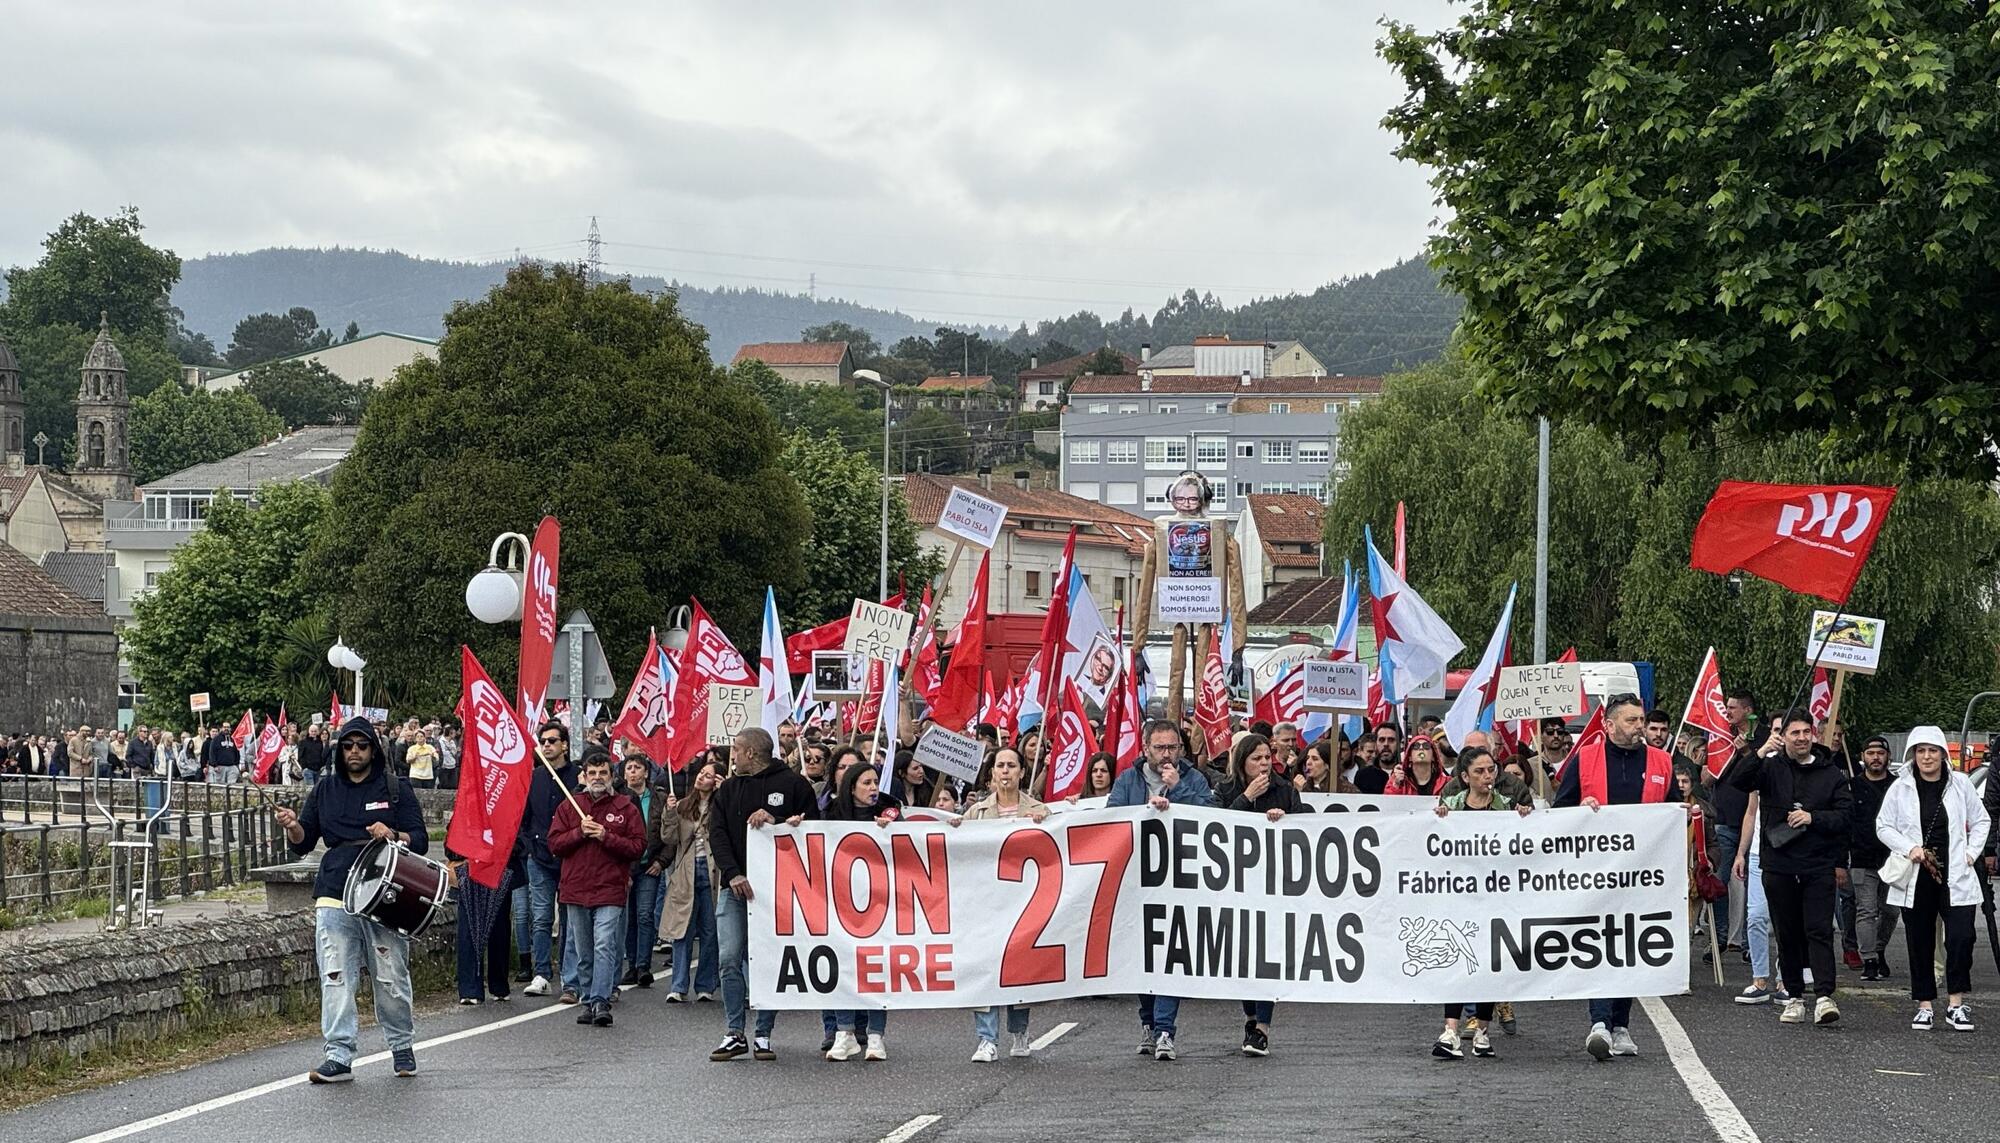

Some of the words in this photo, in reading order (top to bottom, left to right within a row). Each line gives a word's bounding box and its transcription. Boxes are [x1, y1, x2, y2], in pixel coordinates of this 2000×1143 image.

[956, 493, 971, 503] NON
[945, 511, 971, 526] PABLO
[972, 521, 988, 533] ISLA
[867, 628, 890, 643] AO
[1833, 651, 1853, 660] PABLO
[1853, 654, 1867, 662] ISLA
[1519, 665, 1565, 683] NESTLÉ
[1307, 686, 1336, 695] PABLO
[1338, 687, 1357, 696] ISLA
[1501, 686, 1529, 701] QUEN
[1537, 686, 1550, 694] TE
[1554, 684, 1575, 694] VEU
[1534, 697, 1541, 706] E
[726, 712, 742, 729] 27
[1503, 706, 1531, 720] QUEN
[1539, 706, 1552, 716] TE
[1560, 704, 1573, 714] VE
[934, 729, 951, 740] NON
[952, 738, 978, 751] SOMOS
[919, 744, 945, 760] SOMOS
[946, 755, 978, 772] FAMILIAS
[1426, 833, 1501, 857] Comité
[1507, 833, 1533, 856] de
[1540, 834, 1636, 859] empresa
[1139, 817, 1382, 898] DESPIDOS
[774, 831, 951, 938] NON
[1398, 870, 1478, 894] Fábrica
[1485, 870, 1511, 893] de
[1518, 867, 1665, 892] Pontecesures
[997, 820, 1134, 988] 27
[1143, 903, 1365, 984] FAMILIAS
[1490, 910, 1675, 974] Nestlé
[775, 944, 839, 994] AO
[856, 943, 956, 993] ERE
